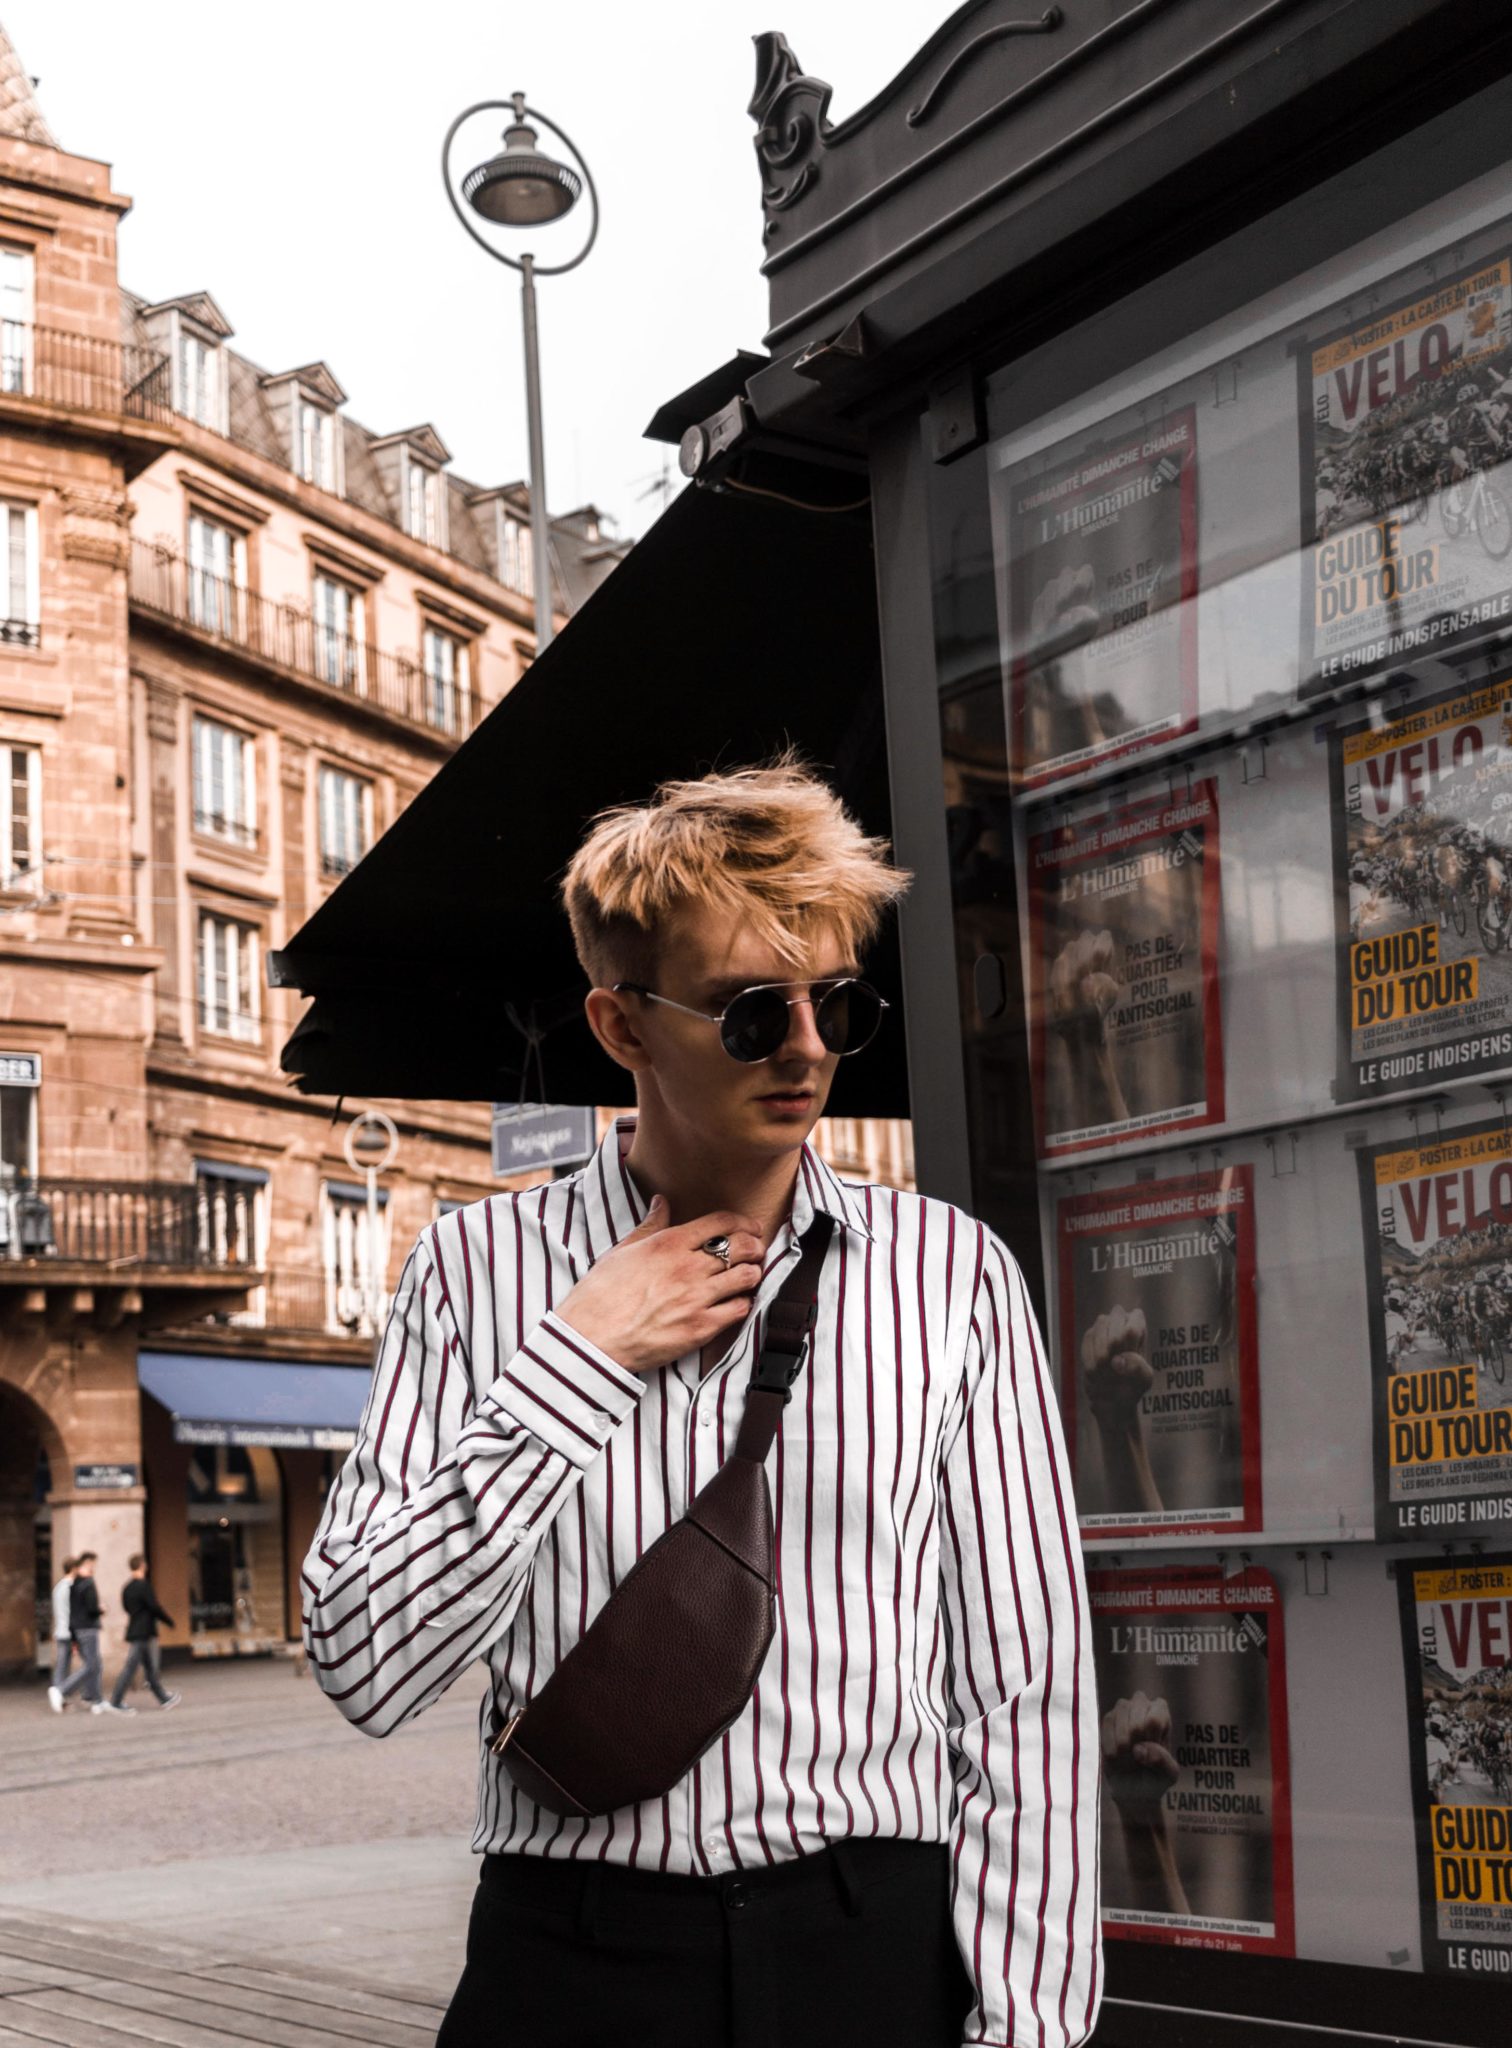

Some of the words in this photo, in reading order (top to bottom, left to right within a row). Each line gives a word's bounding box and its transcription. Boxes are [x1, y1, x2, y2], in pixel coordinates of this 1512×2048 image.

[1352, 321, 1393, 349] POSTER
[1402, 310, 1416, 327] LA
[1418, 293, 1453, 320] CARTE
[1472, 268, 1501, 292] TOUR
[1335, 323, 1450, 421] VELO
[1082, 448, 1139, 486] DIMANCHE
[1142, 424, 1188, 458] CHANGE
[1040, 471, 1162, 544] L'Humanité
[1319, 520, 1398, 582] GUIDE
[1136, 558, 1153, 579] DE
[1321, 576, 1357, 624] DU
[1361, 549, 1435, 607] TOUR
[1112, 601, 1148, 630] POUR
[1321, 656, 1339, 678] LE
[1342, 640, 1386, 672] GUIDE
[1388, 595, 1511, 654] INDISPENSABLE
[1387, 716, 1426, 742] POSTER
[1434, 708, 1449, 725] LA
[1451, 695, 1488, 719] CARTE
[1102, 815, 1159, 847] DIMANCHE
[1163, 799, 1210, 828] CHANGE
[1061, 844, 1185, 903] L'Humanité
[1100, 880, 1139, 901] DIMANCHE
[1125, 939, 1151, 961] PAS
[1155, 934, 1174, 954] DE
[1354, 925, 1437, 982] GUIDE
[1119, 953, 1183, 986] QUARTIER
[1132, 977, 1168, 1002] POUR
[1357, 981, 1394, 1026] DU
[1400, 962, 1473, 1014] TOUR
[1109, 991, 1196, 1029] L'ANTISOCIAL
[1360, 1064, 1376, 1085] LE
[1380, 1053, 1424, 1082] GUIDE
[1420, 1145, 1461, 1167] POSTER
[1471, 1141, 1484, 1155] LA
[1065, 1204, 1131, 1232] L'HUMANITÉ
[1133, 1196, 1194, 1220] DIMANCHE
[1197, 1187, 1245, 1209] CHANGE
[1399, 1162, 1512, 1243] VELO
[1091, 1229, 1219, 1273] L'Humanité
[1133, 1262, 1174, 1278] DIMANCHE
[1160, 1327, 1185, 1347] PAS
[1191, 1324, 1210, 1343] DE
[1152, 1345, 1219, 1371] QUARTIER
[1167, 1369, 1204, 1389] POUR
[1392, 1367, 1475, 1417] GUIDE
[1142, 1388, 1233, 1415] L'ANTISOCIAL
[1395, 1420, 1434, 1464] DU
[1438, 1410, 1512, 1458] TOUR
[1436, 1475, 1459, 1487] PLANS
[1399, 1506, 1416, 1527] LE
[1420, 1501, 1467, 1526] GUIDE
[1461, 1572, 1504, 1590] POSTER
[1156, 1588, 1220, 1606] DIMANCHE
[1223, 1587, 1274, 1604] CHANGE
[1110, 1626, 1249, 1653] L'Humanité
[1156, 1654, 1199, 1665] DIMANCHE
[1185, 1724, 1214, 1743] PAS
[1219, 1725, 1239, 1744] DE
[1176, 1746, 1251, 1767] QUARTIER
[1194, 1770, 1235, 1790] POUR
[1167, 1791, 1264, 1815] L'ANTISOCIAL
[1441, 1857, 1482, 1901] DU
[1448, 1947, 1467, 1969] LE
[1471, 1949, 1512, 1972] GUID
